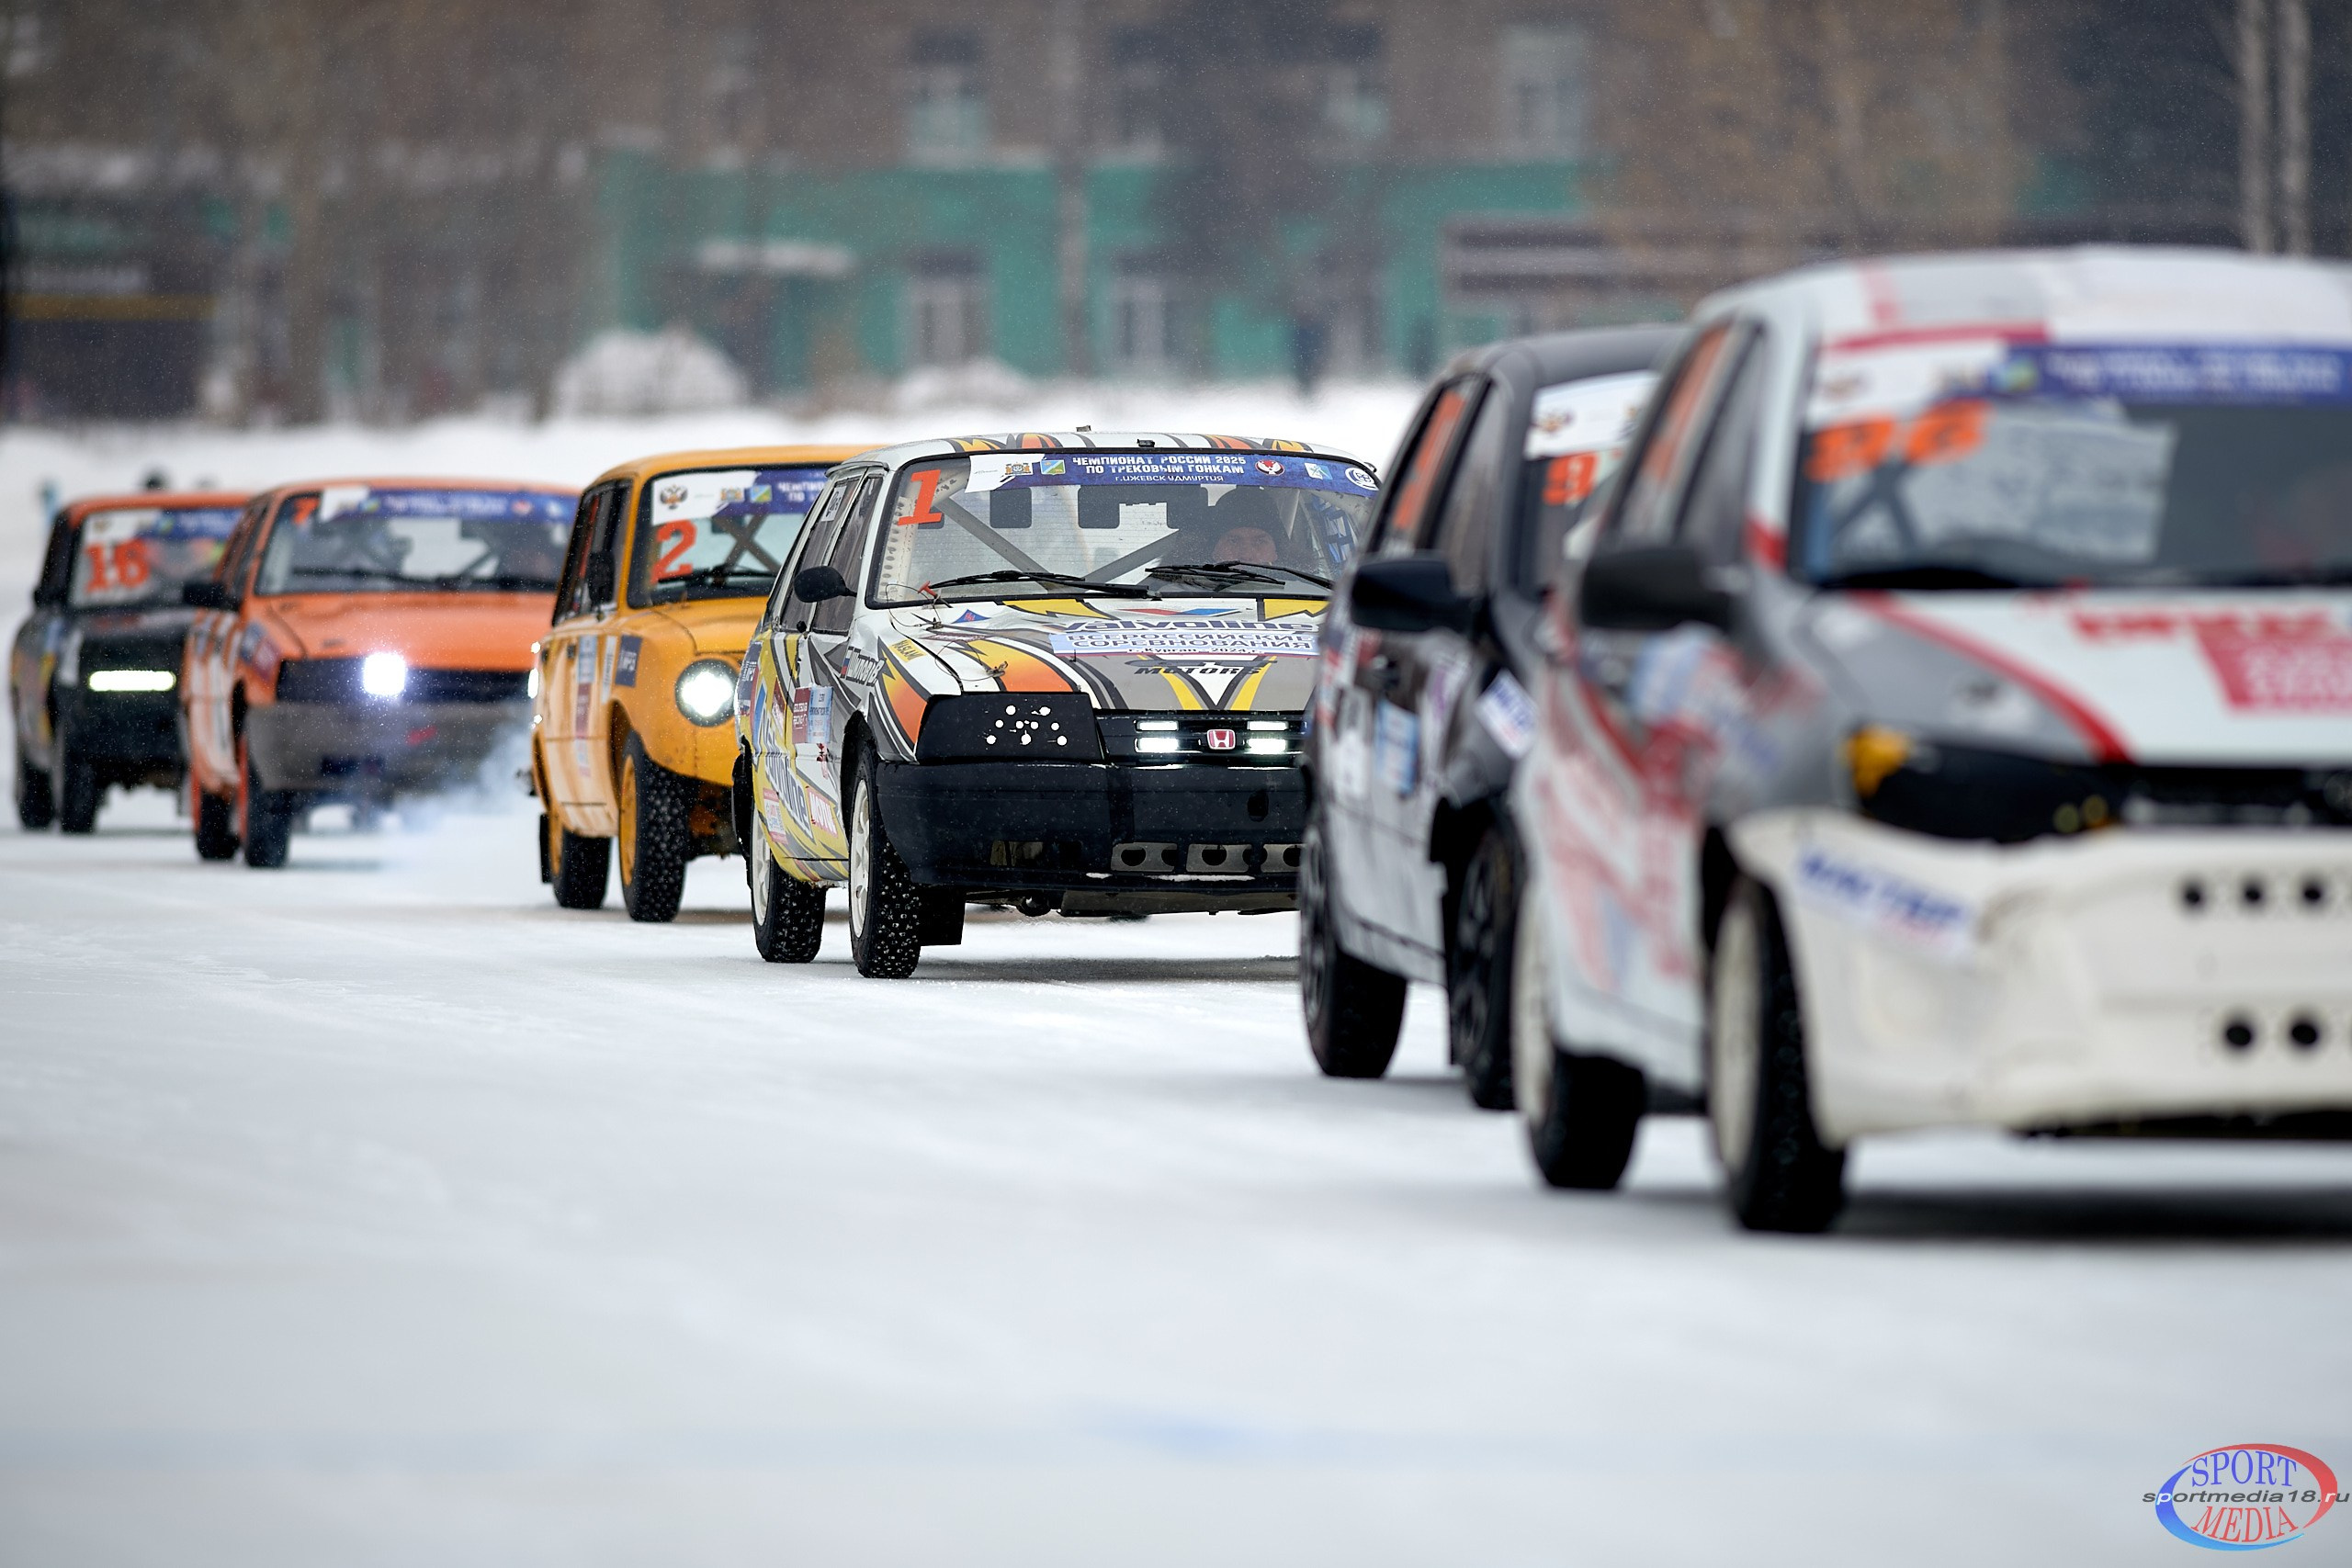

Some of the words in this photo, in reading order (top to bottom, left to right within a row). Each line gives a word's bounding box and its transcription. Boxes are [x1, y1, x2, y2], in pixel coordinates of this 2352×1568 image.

[1073, 456, 1153, 466] ЧЕМПИОНАТ
[1160, 456, 1212, 464] РОССИИ
[1215, 456, 1247, 465] 2025
[1085, 465, 1104, 474] ПО
[1110, 465, 1184, 474] ТРЕКОВЫМ
[1188, 465, 1245, 474] ГОНКАМ
[898, 468, 942, 525] 1
[650, 519, 697, 584] 2
[1073, 640, 1311, 649] СОРЕВНОВАНИЯ
[1134, 667, 1262, 675] MOTORS
